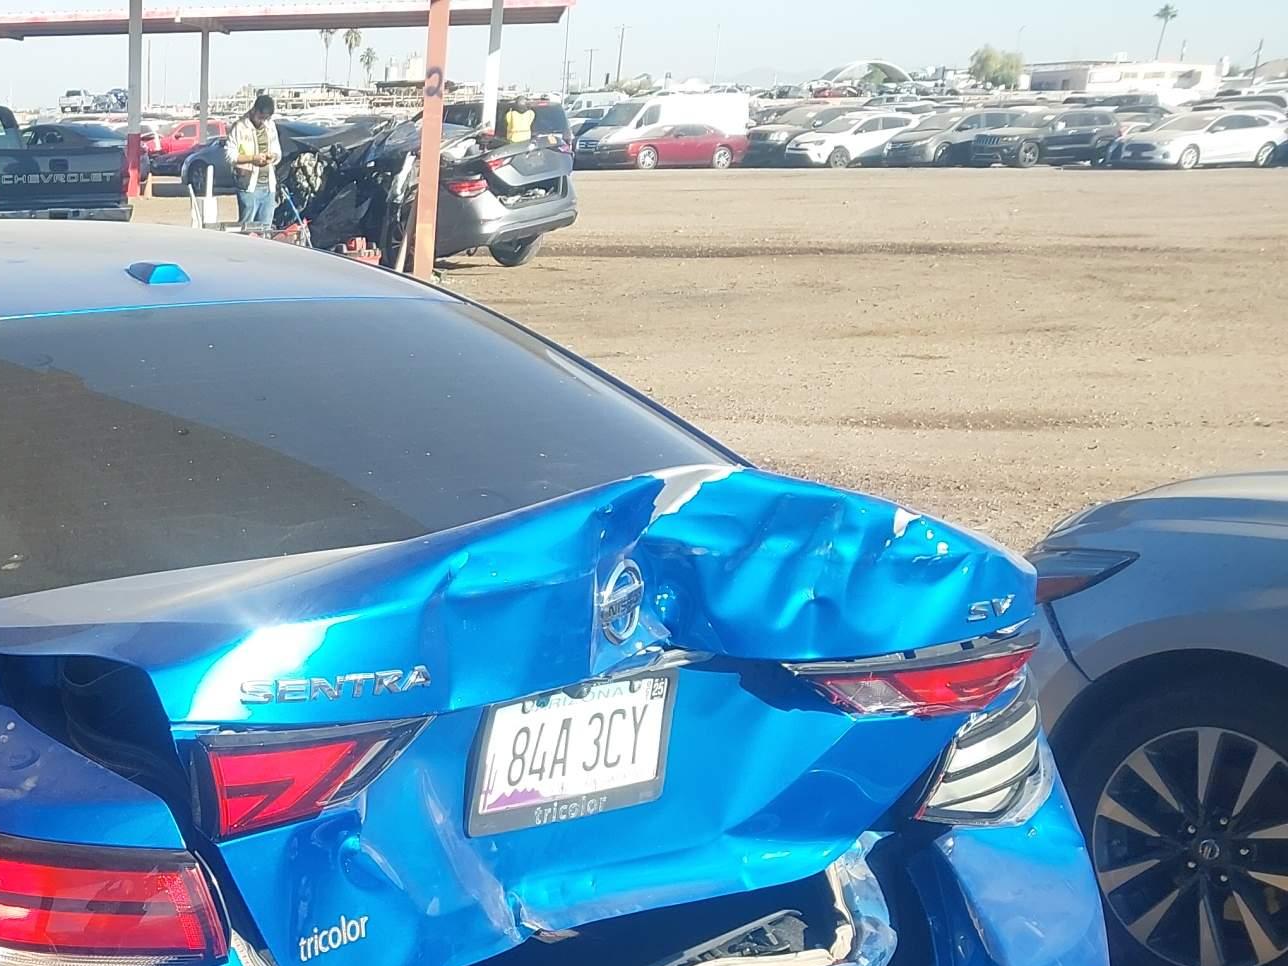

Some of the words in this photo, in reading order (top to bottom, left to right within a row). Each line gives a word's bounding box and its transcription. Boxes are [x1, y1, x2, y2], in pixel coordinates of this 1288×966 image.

[425, 66, 443, 97] 2
[1, 172, 115, 185] CHEVROLET
[967, 593, 1016, 622] SV
[240, 664, 431, 705] SENTRA
[651, 681, 665, 697] 25
[507, 717, 573, 787] 84A
[582, 704, 649, 772] 3CY
[534, 795, 607, 825] tricolor
[299, 914, 369, 962] tricolor
